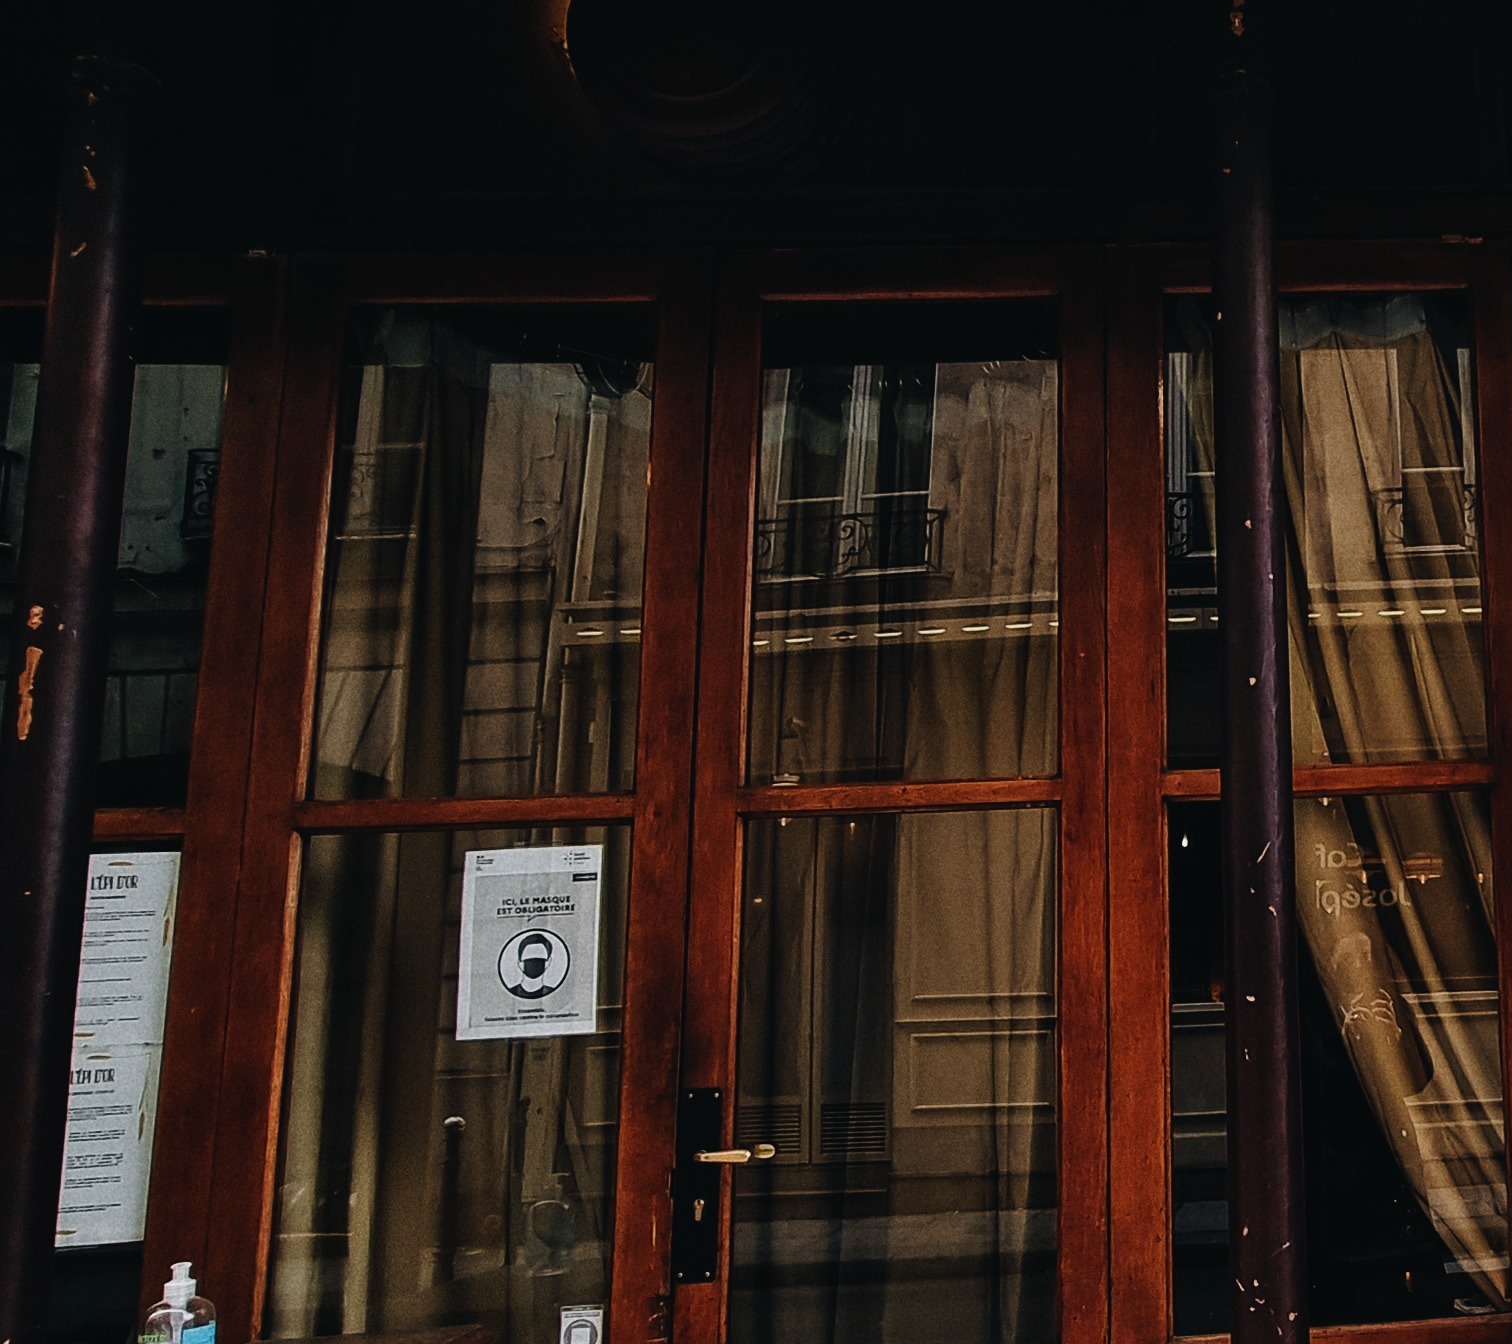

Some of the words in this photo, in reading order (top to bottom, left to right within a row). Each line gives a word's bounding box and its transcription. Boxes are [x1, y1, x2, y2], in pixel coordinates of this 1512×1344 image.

[532, 895, 571, 905] MASQUE
[496, 906, 513, 916] EST
[514, 903, 576, 915] OBLIGATOIRE
